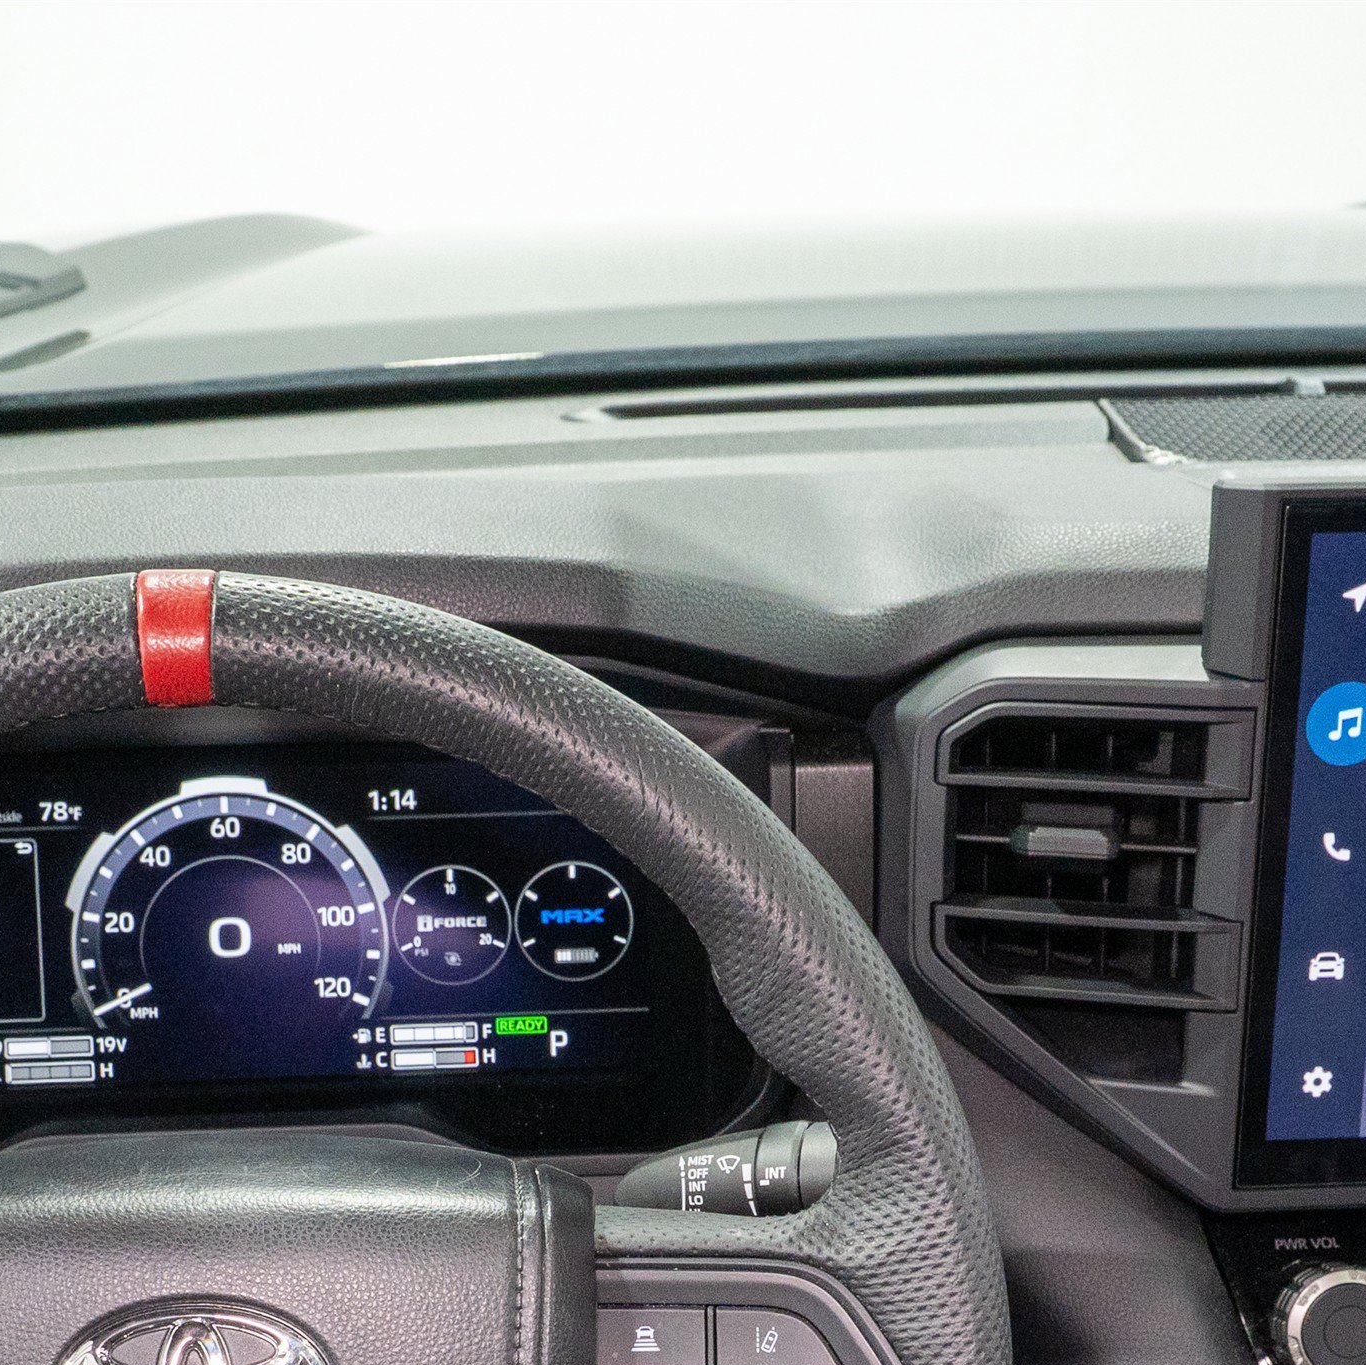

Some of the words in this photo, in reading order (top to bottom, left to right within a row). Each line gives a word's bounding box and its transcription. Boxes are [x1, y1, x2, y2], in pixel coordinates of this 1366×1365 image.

[368, 789, 417, 812] 1:14
[210, 817, 241, 838] 60
[140, 845, 171, 867] 40
[281, 843, 311, 865] 80
[444, 883, 456, 895] 10
[104, 912, 135, 933] 20
[317, 906, 355, 927] 100
[541, 908, 605, 925] MAX
[209, 916, 251, 958] 0
[277, 943, 302, 955] MPH
[413, 936, 422, 947] 0
[479, 934, 492, 946] 20
[314, 977, 351, 998] 120
[131, 1007, 158, 1019] MPH
[375, 1027, 386, 1043] E
[482, 1023, 493, 1039] F
[499, 1018, 544, 1033] READY
[96, 1037, 127, 1053] 19V
[549, 1029, 569, 1058] P
[375, 1052, 388, 1067] C
[483, 1049, 496, 1064] H
[100, 1063, 114, 1079] H
[687, 1154, 715, 1167] MIST
[688, 1168, 710, 1179] OFF
[765, 1165, 787, 1179] INT
[689, 1180, 708, 1192] INT
[689, 1195, 704, 1206] LO
[1275, 1237, 1308, 1251] PWR
[1310, 1236, 1340, 1250] VOL
